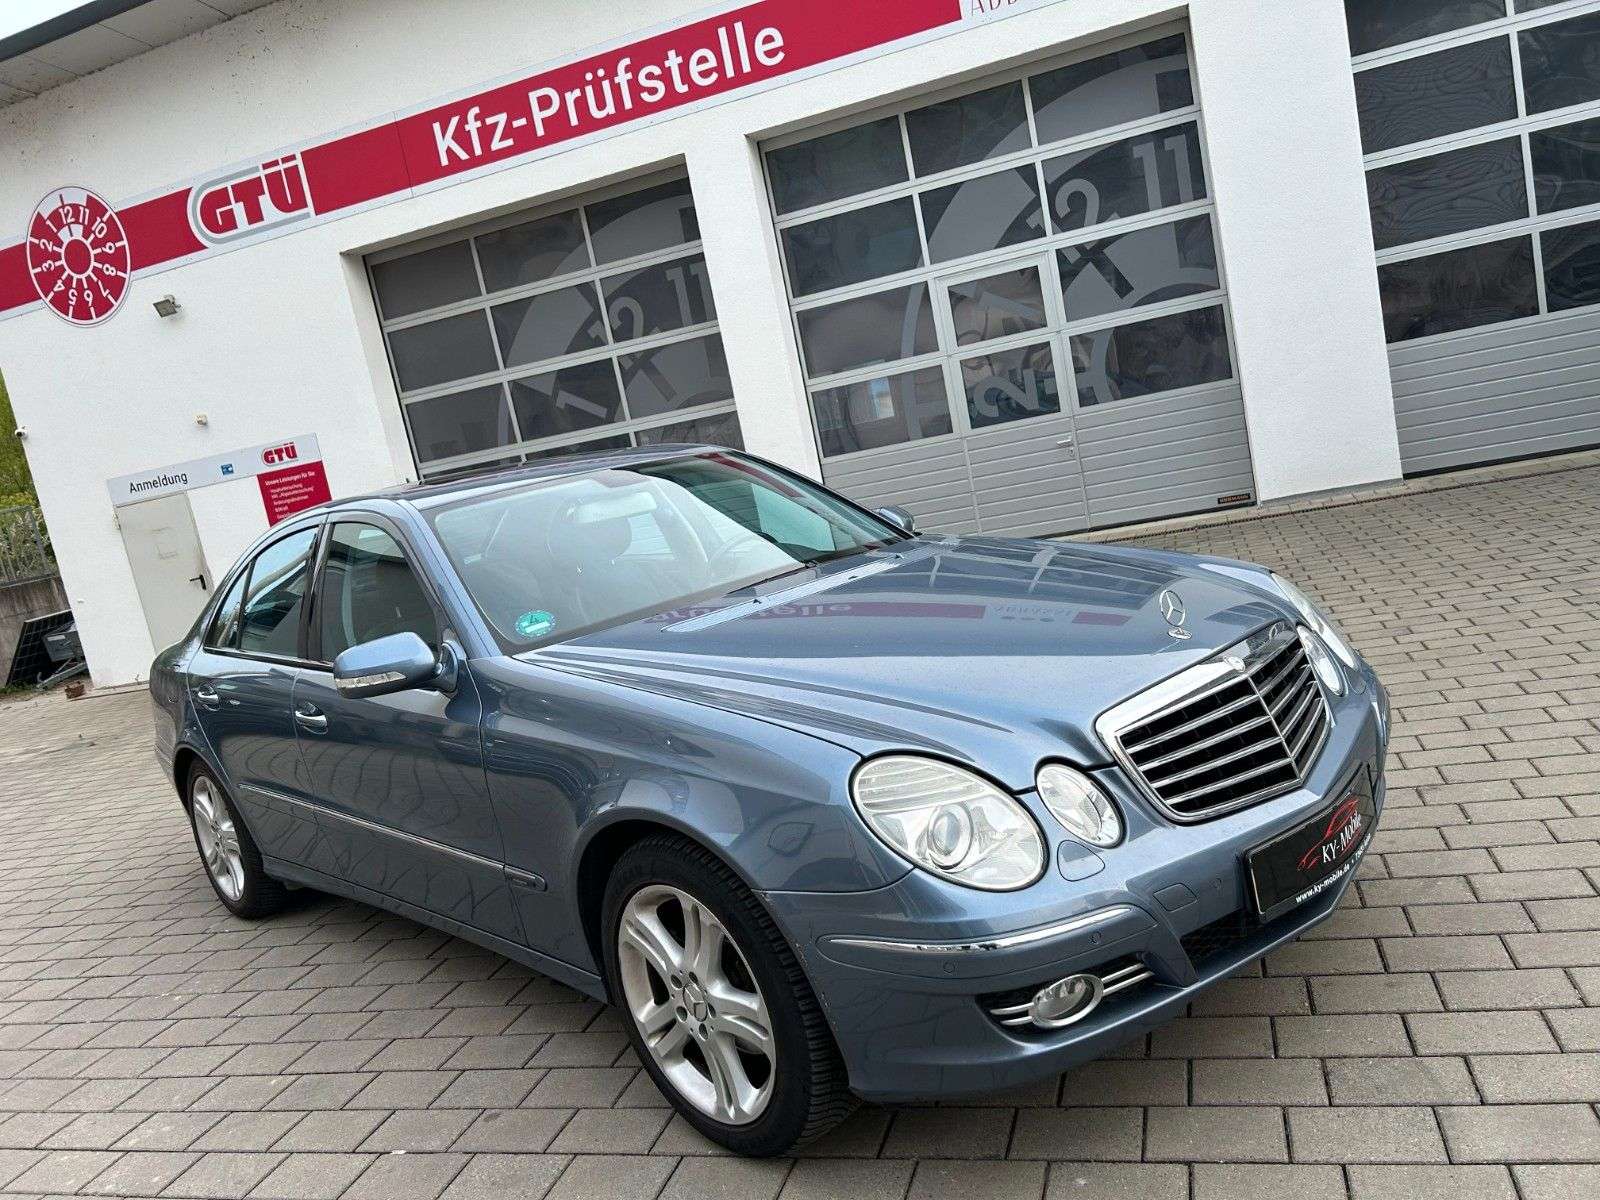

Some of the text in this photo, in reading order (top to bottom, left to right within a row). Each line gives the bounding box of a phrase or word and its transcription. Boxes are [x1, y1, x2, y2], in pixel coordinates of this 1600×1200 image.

[432, 21, 786, 167] Kfz-Prüfstelle
[199, 153, 309, 235] GTÜ
[1133, 134, 1194, 210] 11
[40, 206, 116, 306] 12 11 10 9 8 7 6 5 4 3 2 1
[129, 472, 188, 493] Anmeldung
[263, 441, 297, 464] GTÜ
